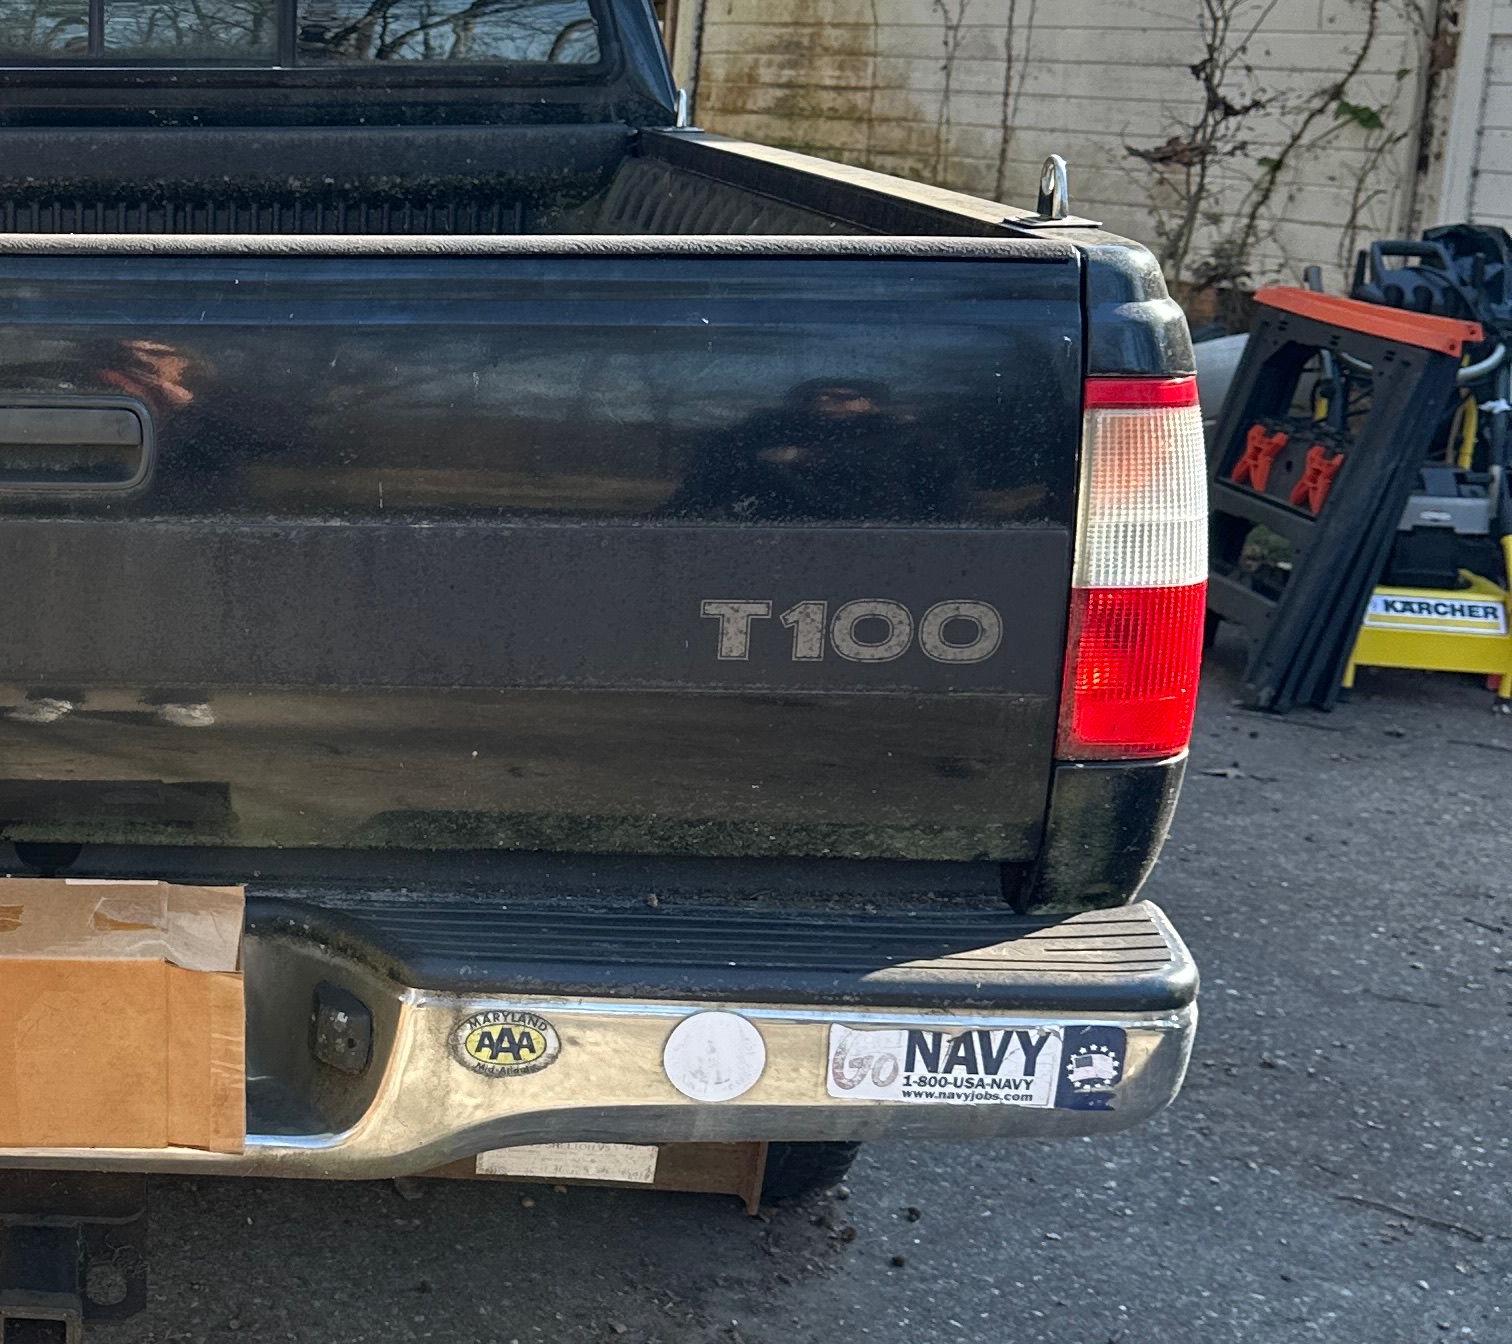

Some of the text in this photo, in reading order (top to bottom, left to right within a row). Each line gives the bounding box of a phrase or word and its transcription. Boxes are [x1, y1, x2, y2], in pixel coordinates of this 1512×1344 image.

[700, 599, 1004, 664] T100
[469, 1011, 548, 1032] MARYLAND
[474, 1027, 537, 1061] AAA
[903, 1029, 1048, 1077] NAVY
[901, 1074, 1034, 1091] 1-800-USA-NAVY
[901, 1088, 1034, 1103] www.navyjobs.com
